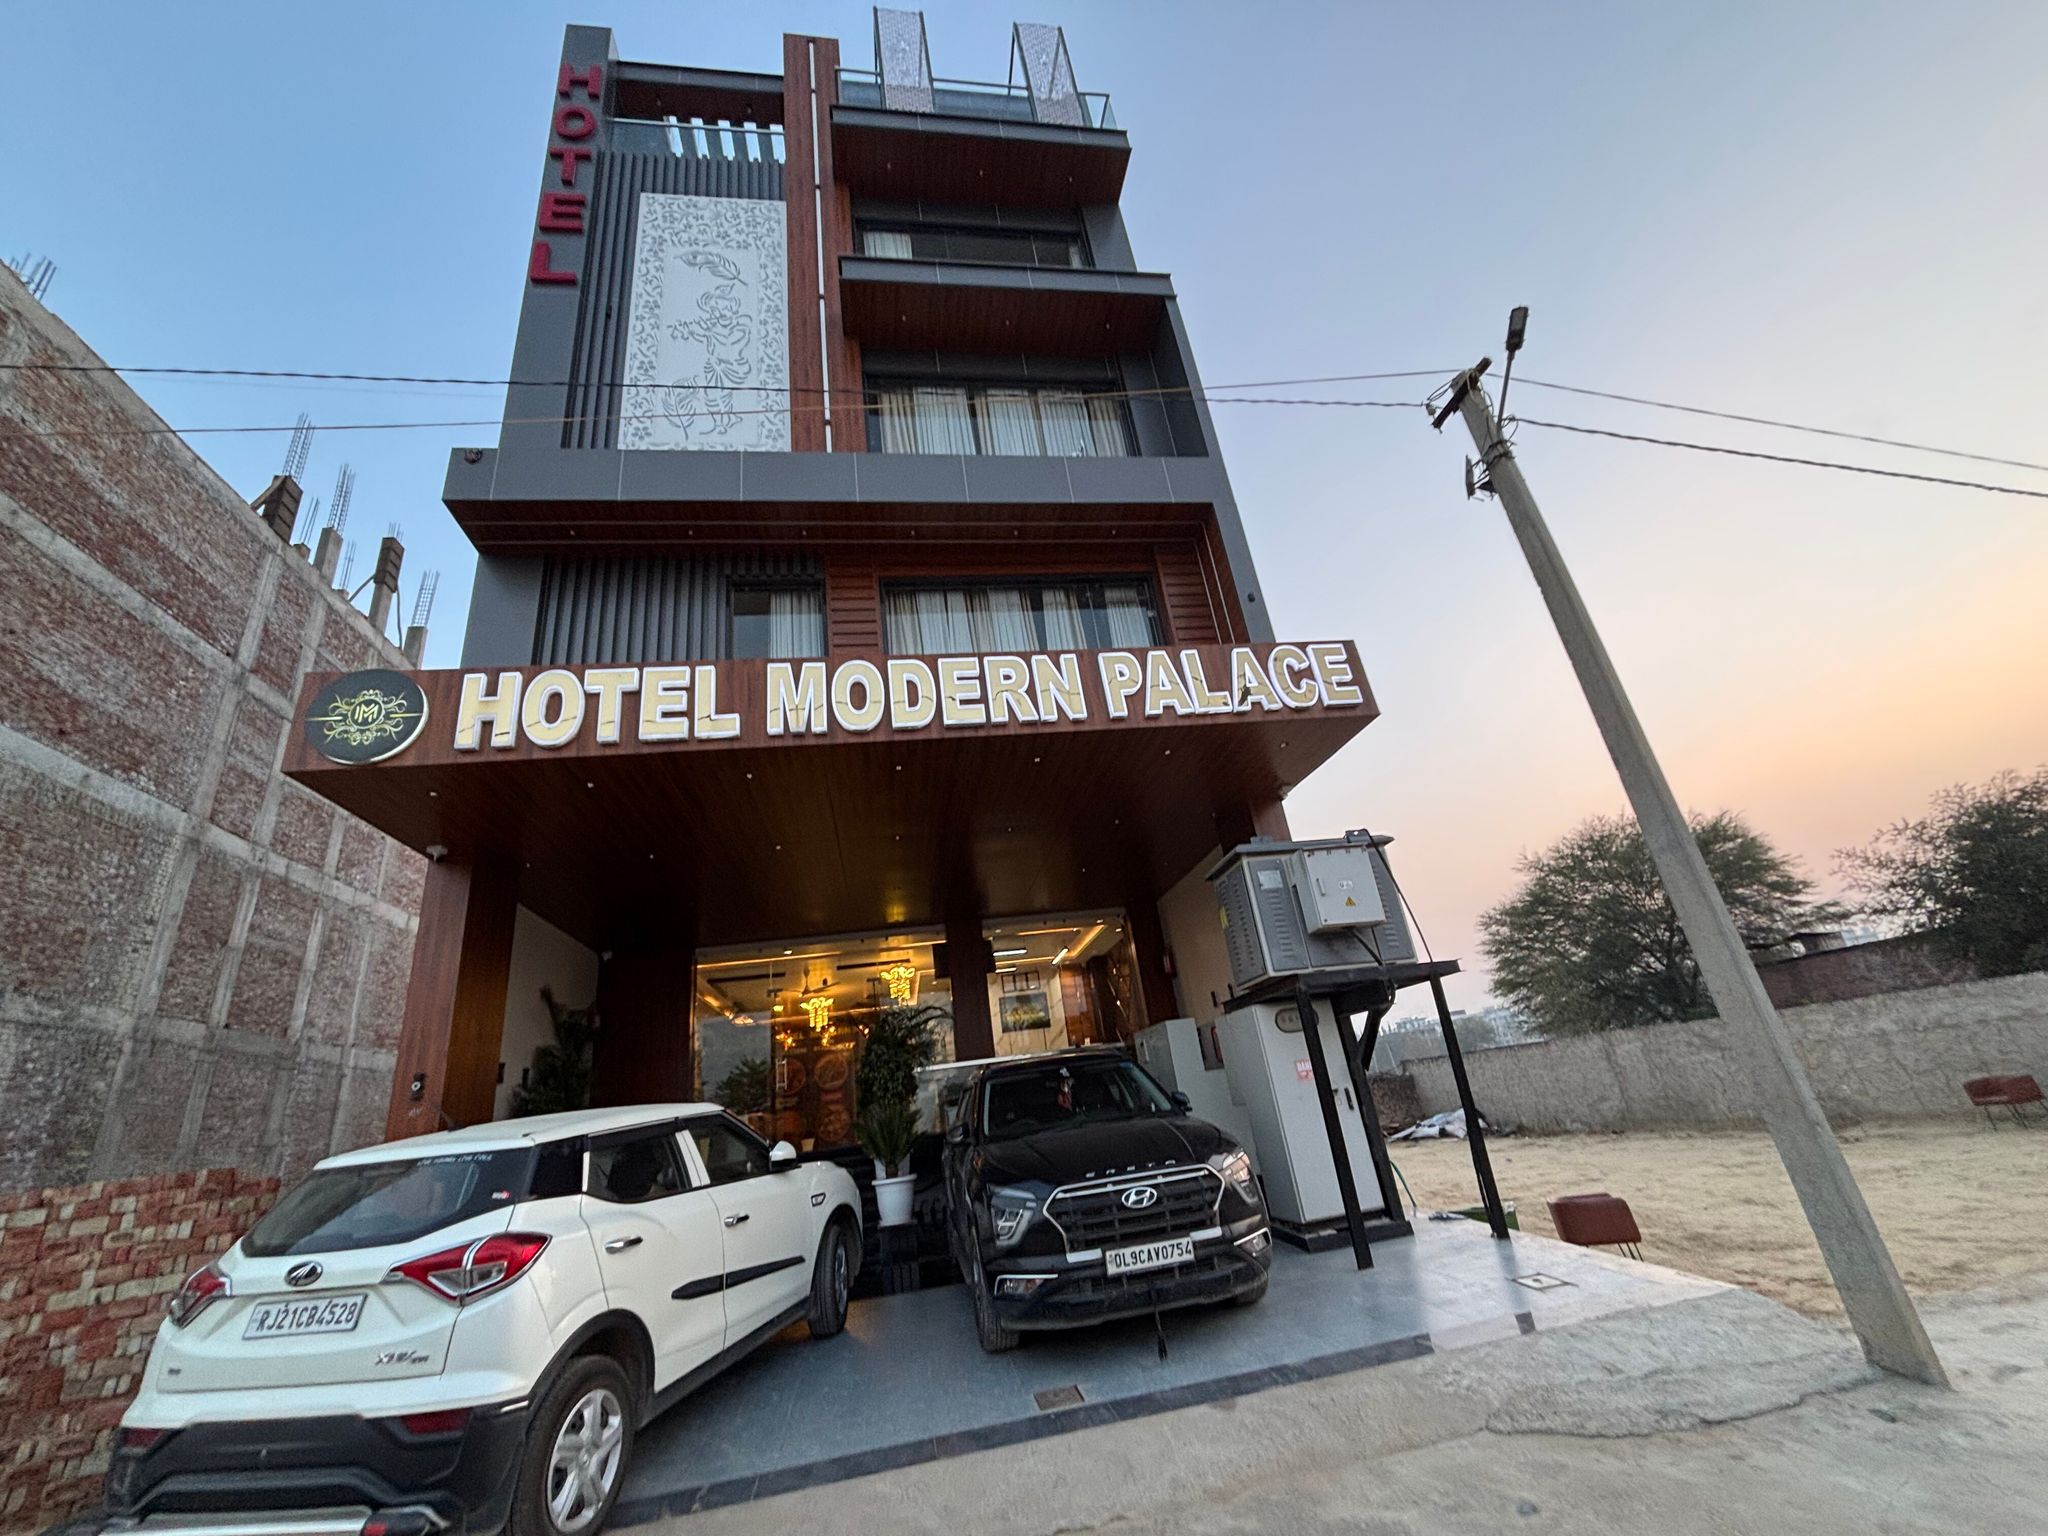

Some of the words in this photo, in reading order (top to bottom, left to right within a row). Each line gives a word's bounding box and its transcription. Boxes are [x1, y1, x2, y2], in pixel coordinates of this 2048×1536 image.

[529, 63, 602, 286] HOTEL
[453, 665, 741, 752] HOTEL
[766, 652, 1088, 737] MODERN
[1098, 643, 1364, 720] PALACE
[1114, 1241, 1192, 1268] DL9CAV0754
[256, 1300, 358, 1332] RJ21CB4528
